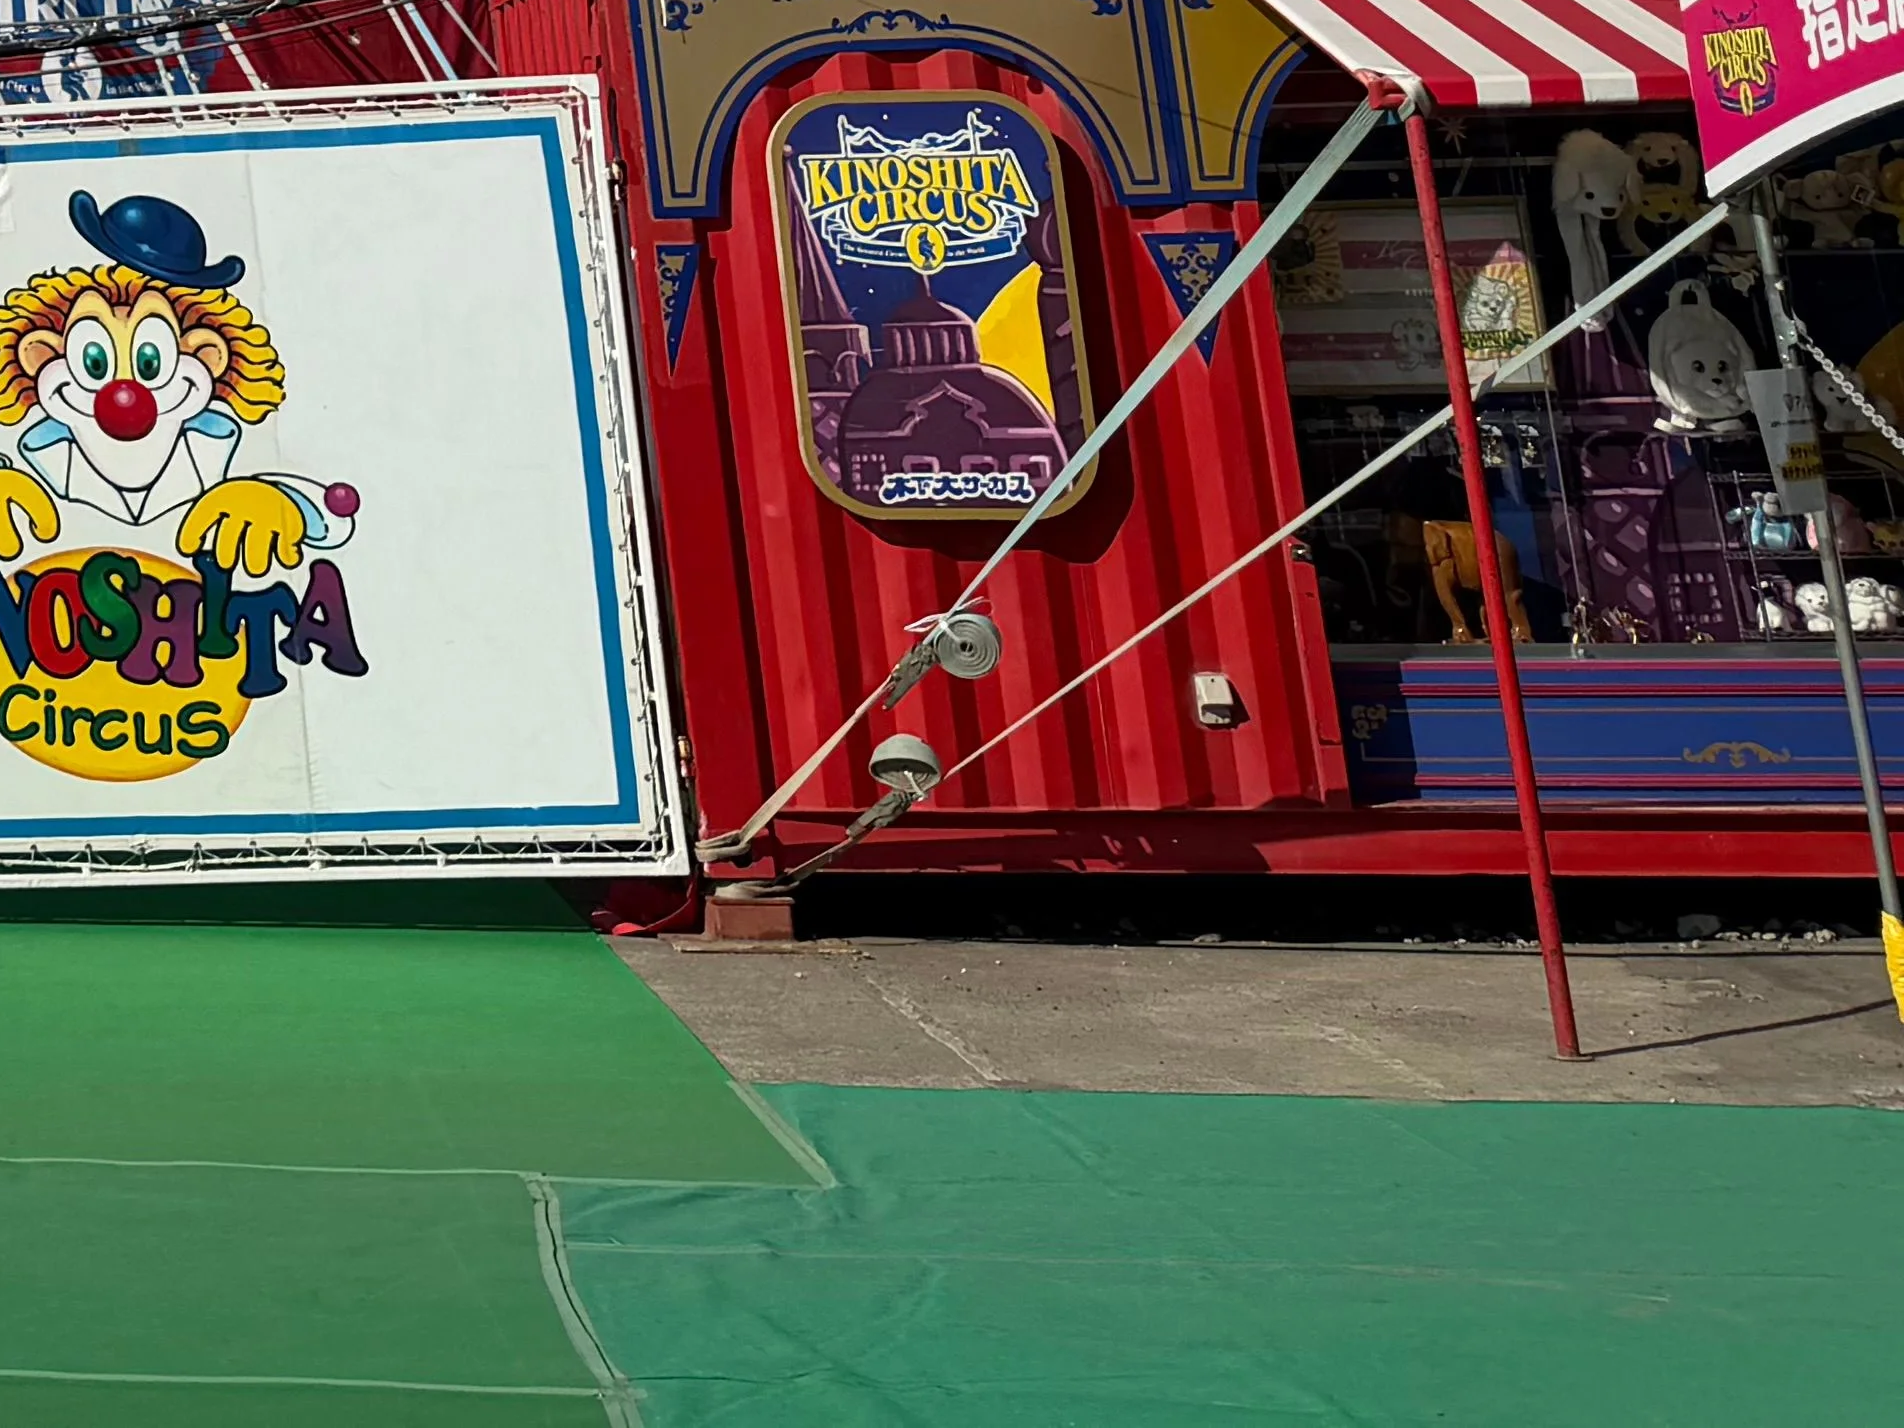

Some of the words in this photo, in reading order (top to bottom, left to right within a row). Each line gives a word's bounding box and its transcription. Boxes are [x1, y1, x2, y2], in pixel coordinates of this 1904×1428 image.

[1703, 26, 1779, 73] KINOSHITA
[1719, 56, 1768, 90] CIRCUS
[805, 154, 1033, 209] KINOSHITA
[850, 188, 995, 232] CIRCUS
[881, 474, 1034, 502] 木下大サーカス
